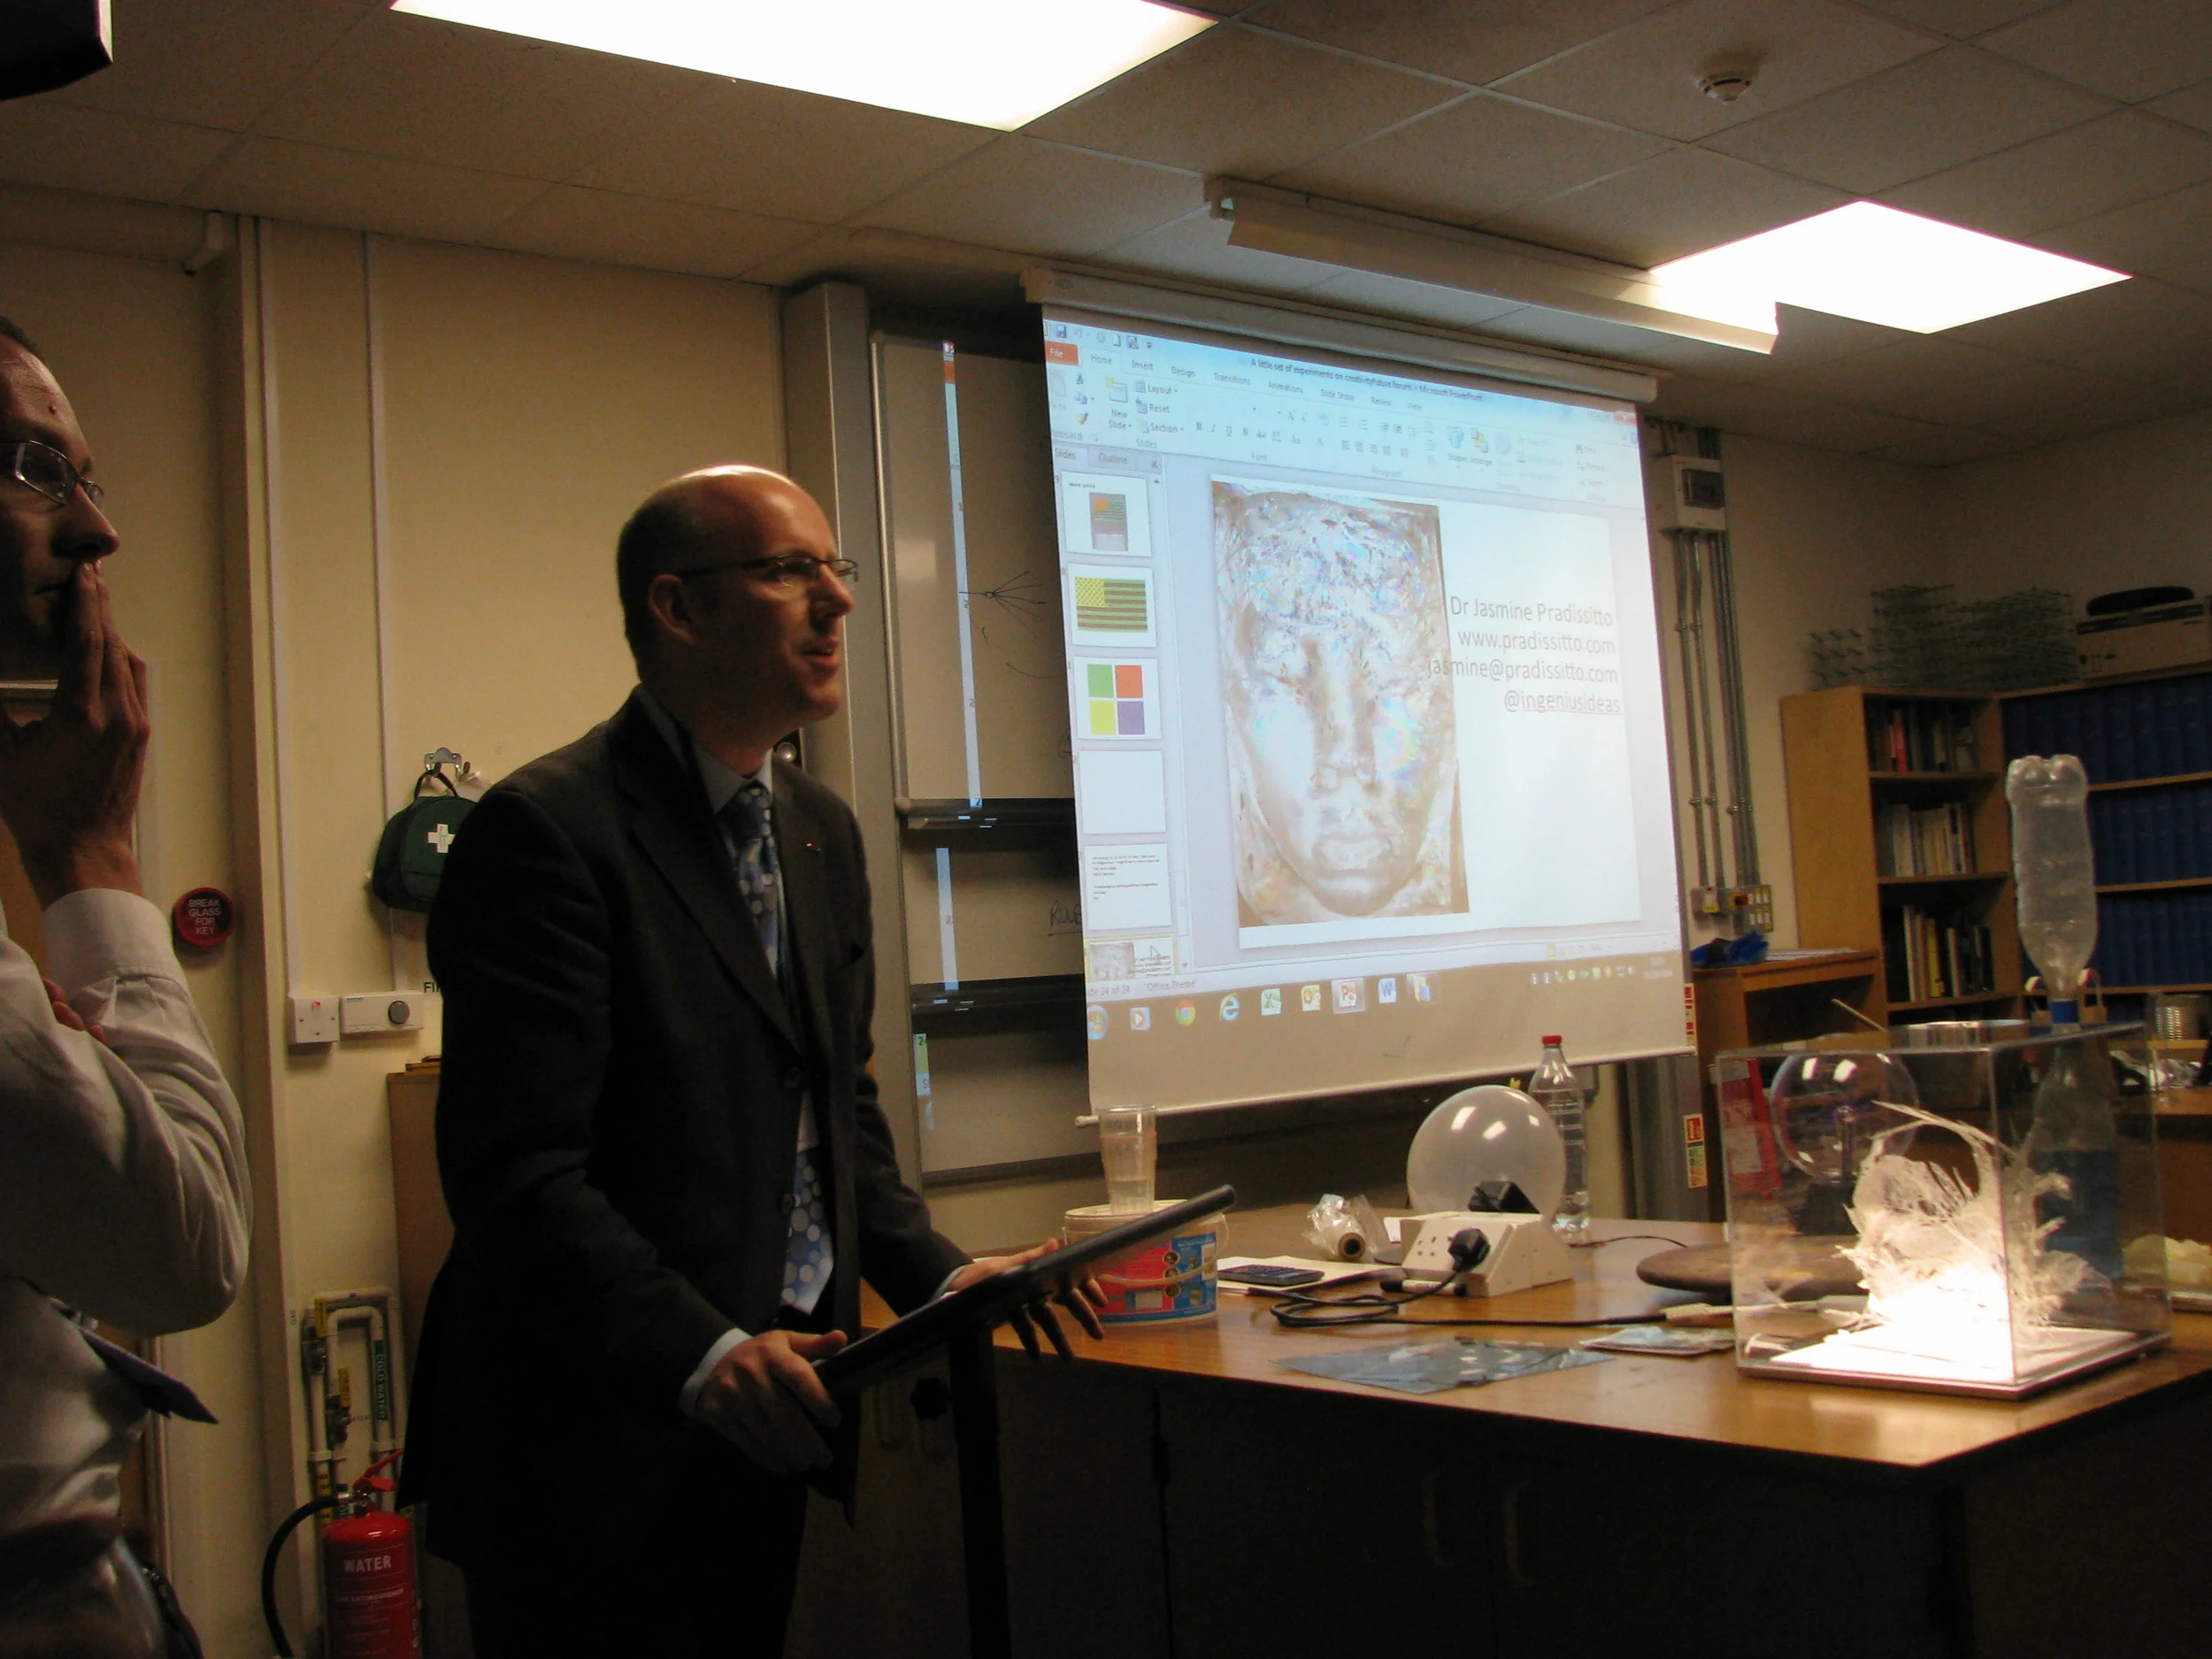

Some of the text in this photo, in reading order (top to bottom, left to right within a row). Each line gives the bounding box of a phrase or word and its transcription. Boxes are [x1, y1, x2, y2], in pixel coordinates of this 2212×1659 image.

[1049, 349, 1064, 358] File
[1090, 354, 1112, 365] Home
[1132, 359, 1154, 372] Insert
[1171, 365, 1196, 379] Design
[1214, 373, 1251, 386] Transitions
[1148, 384, 1172, 396] Layout
[1149, 403, 1170, 413] Reset
[1150, 422, 1178, 433] Section
[1449, 596, 1613, 627] Dr Jasmine Pradissitto
[1458, 629, 1615, 654] www.pradissitto.com
[1427, 657, 1617, 683] jasmine@pradissitto.com
[1505, 690, 1620, 713] @ingeniusideas
[188, 898, 220, 908] BREAK
[189, 908, 221, 917] GLASS
[195, 917, 216, 926] FOR
[195, 926, 216, 935] KEY
[343, 1555, 392, 1573] WATER
